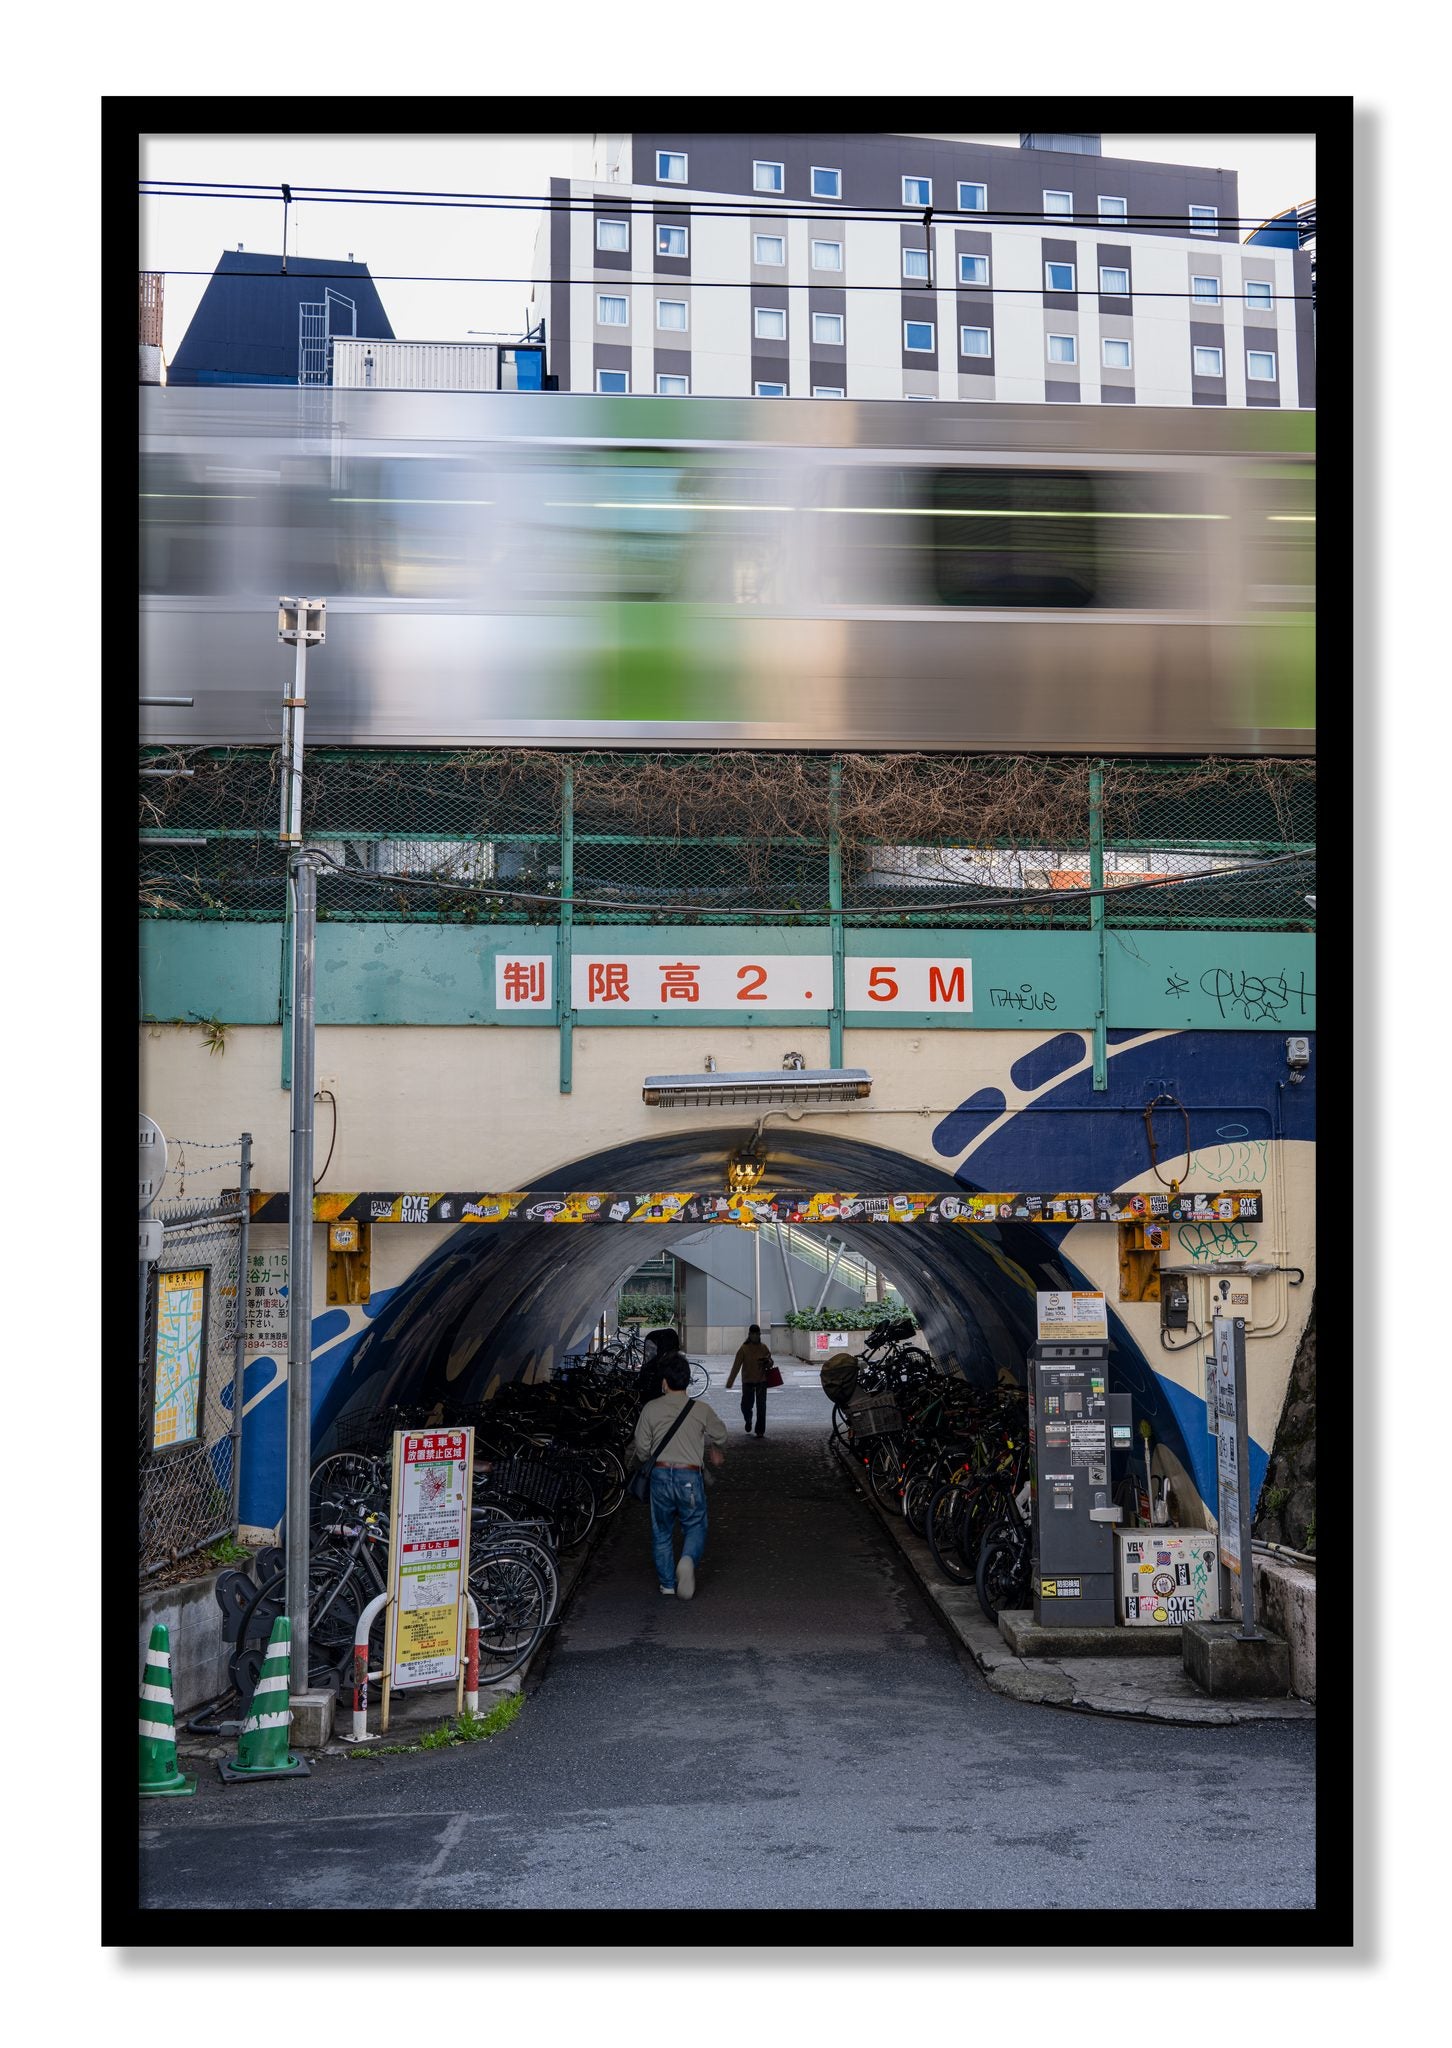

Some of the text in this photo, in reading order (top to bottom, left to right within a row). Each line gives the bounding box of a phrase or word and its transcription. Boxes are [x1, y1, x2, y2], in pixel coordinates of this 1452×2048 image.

[402, 1195, 430, 1210] OYE
[1239, 1198, 1257, 1207] OYE
[401, 1209, 429, 1223] RUNS
[1240, 1206, 1258, 1216] RUNS
[408, 1436, 462, 1449] 自転車等
[407, 1447, 462, 1461] 放置禁止区域
[1167, 1596, 1194, 1611] OYE
[1168, 1610, 1195, 1625] RUNS
